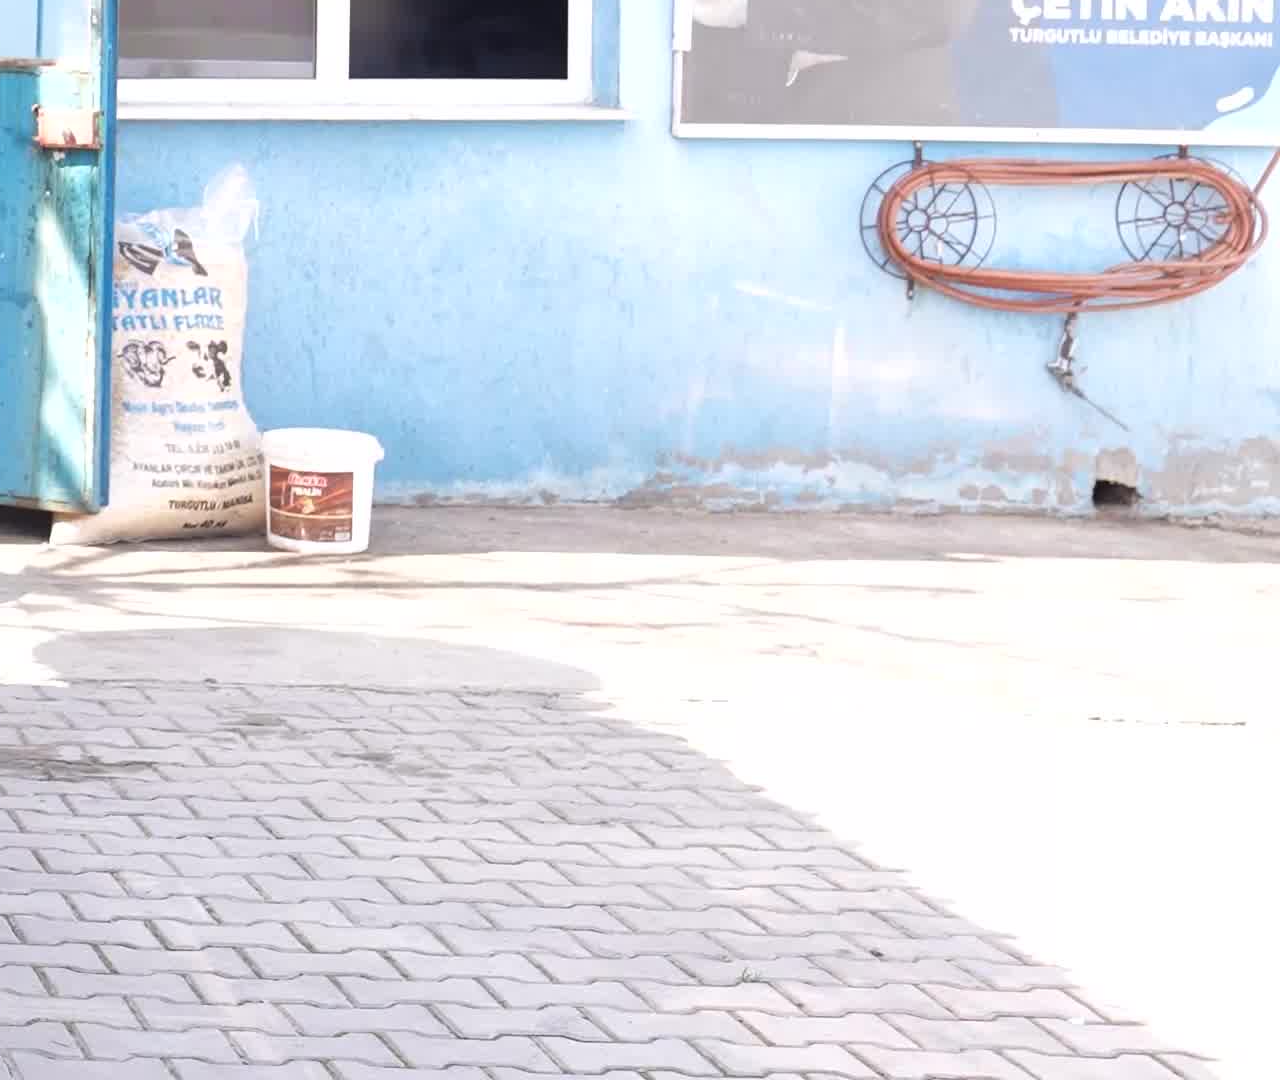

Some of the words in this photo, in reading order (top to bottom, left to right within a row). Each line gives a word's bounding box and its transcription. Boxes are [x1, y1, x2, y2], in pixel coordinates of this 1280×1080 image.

[1009, 27, 1101, 46] TURGUTLU
[1106, 27, 1191, 47] BELEDİYE
[1195, 30, 1274, 50] BAŞKANI
